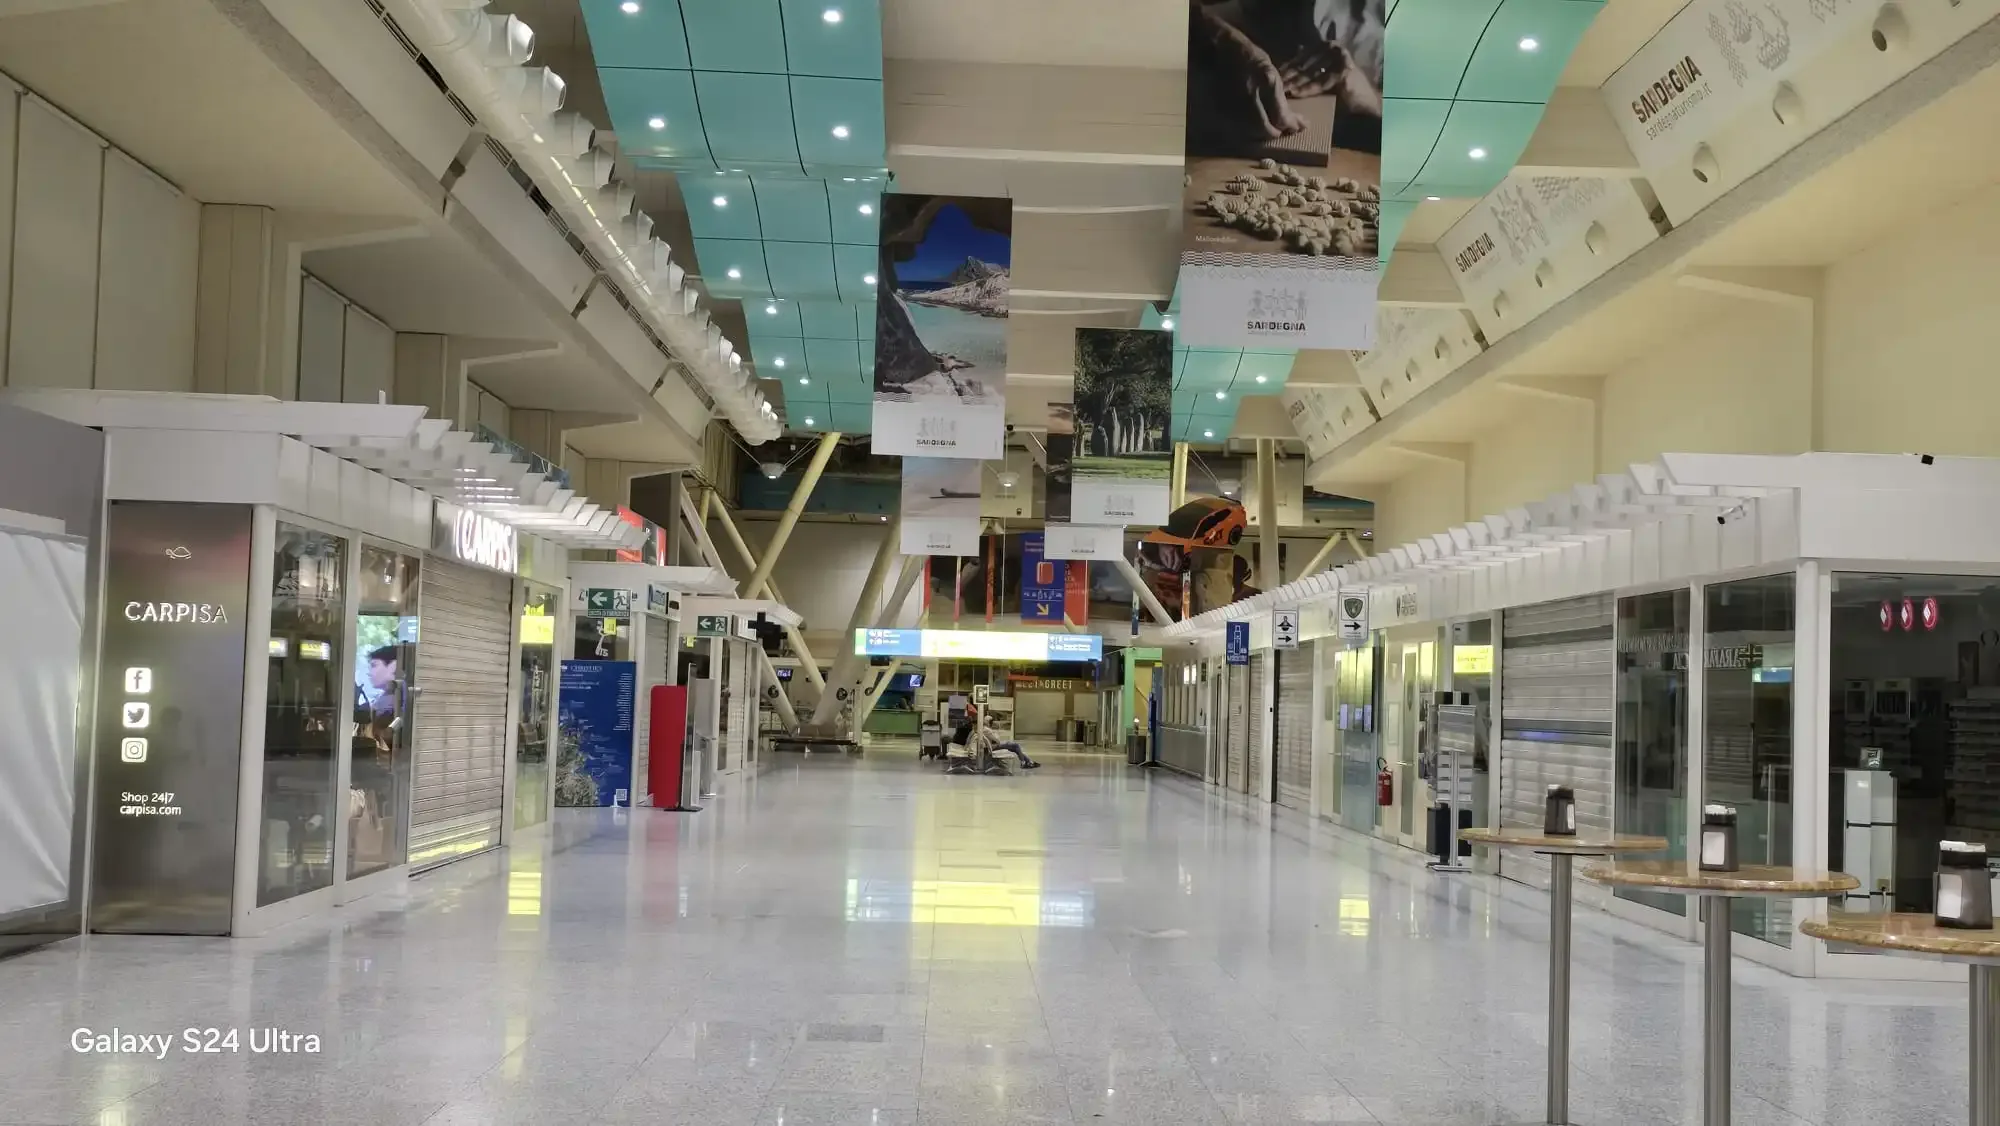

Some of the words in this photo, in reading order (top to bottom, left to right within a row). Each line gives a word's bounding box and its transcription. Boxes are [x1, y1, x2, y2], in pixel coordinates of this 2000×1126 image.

[1632, 56, 1702, 123] SARDEGNA
[1247, 321, 1306, 331] SARDEGNA
[125, 601, 228, 624] CARPISA
[121, 792, 148, 804] Shop
[120, 804, 182, 817] carpisa.com
